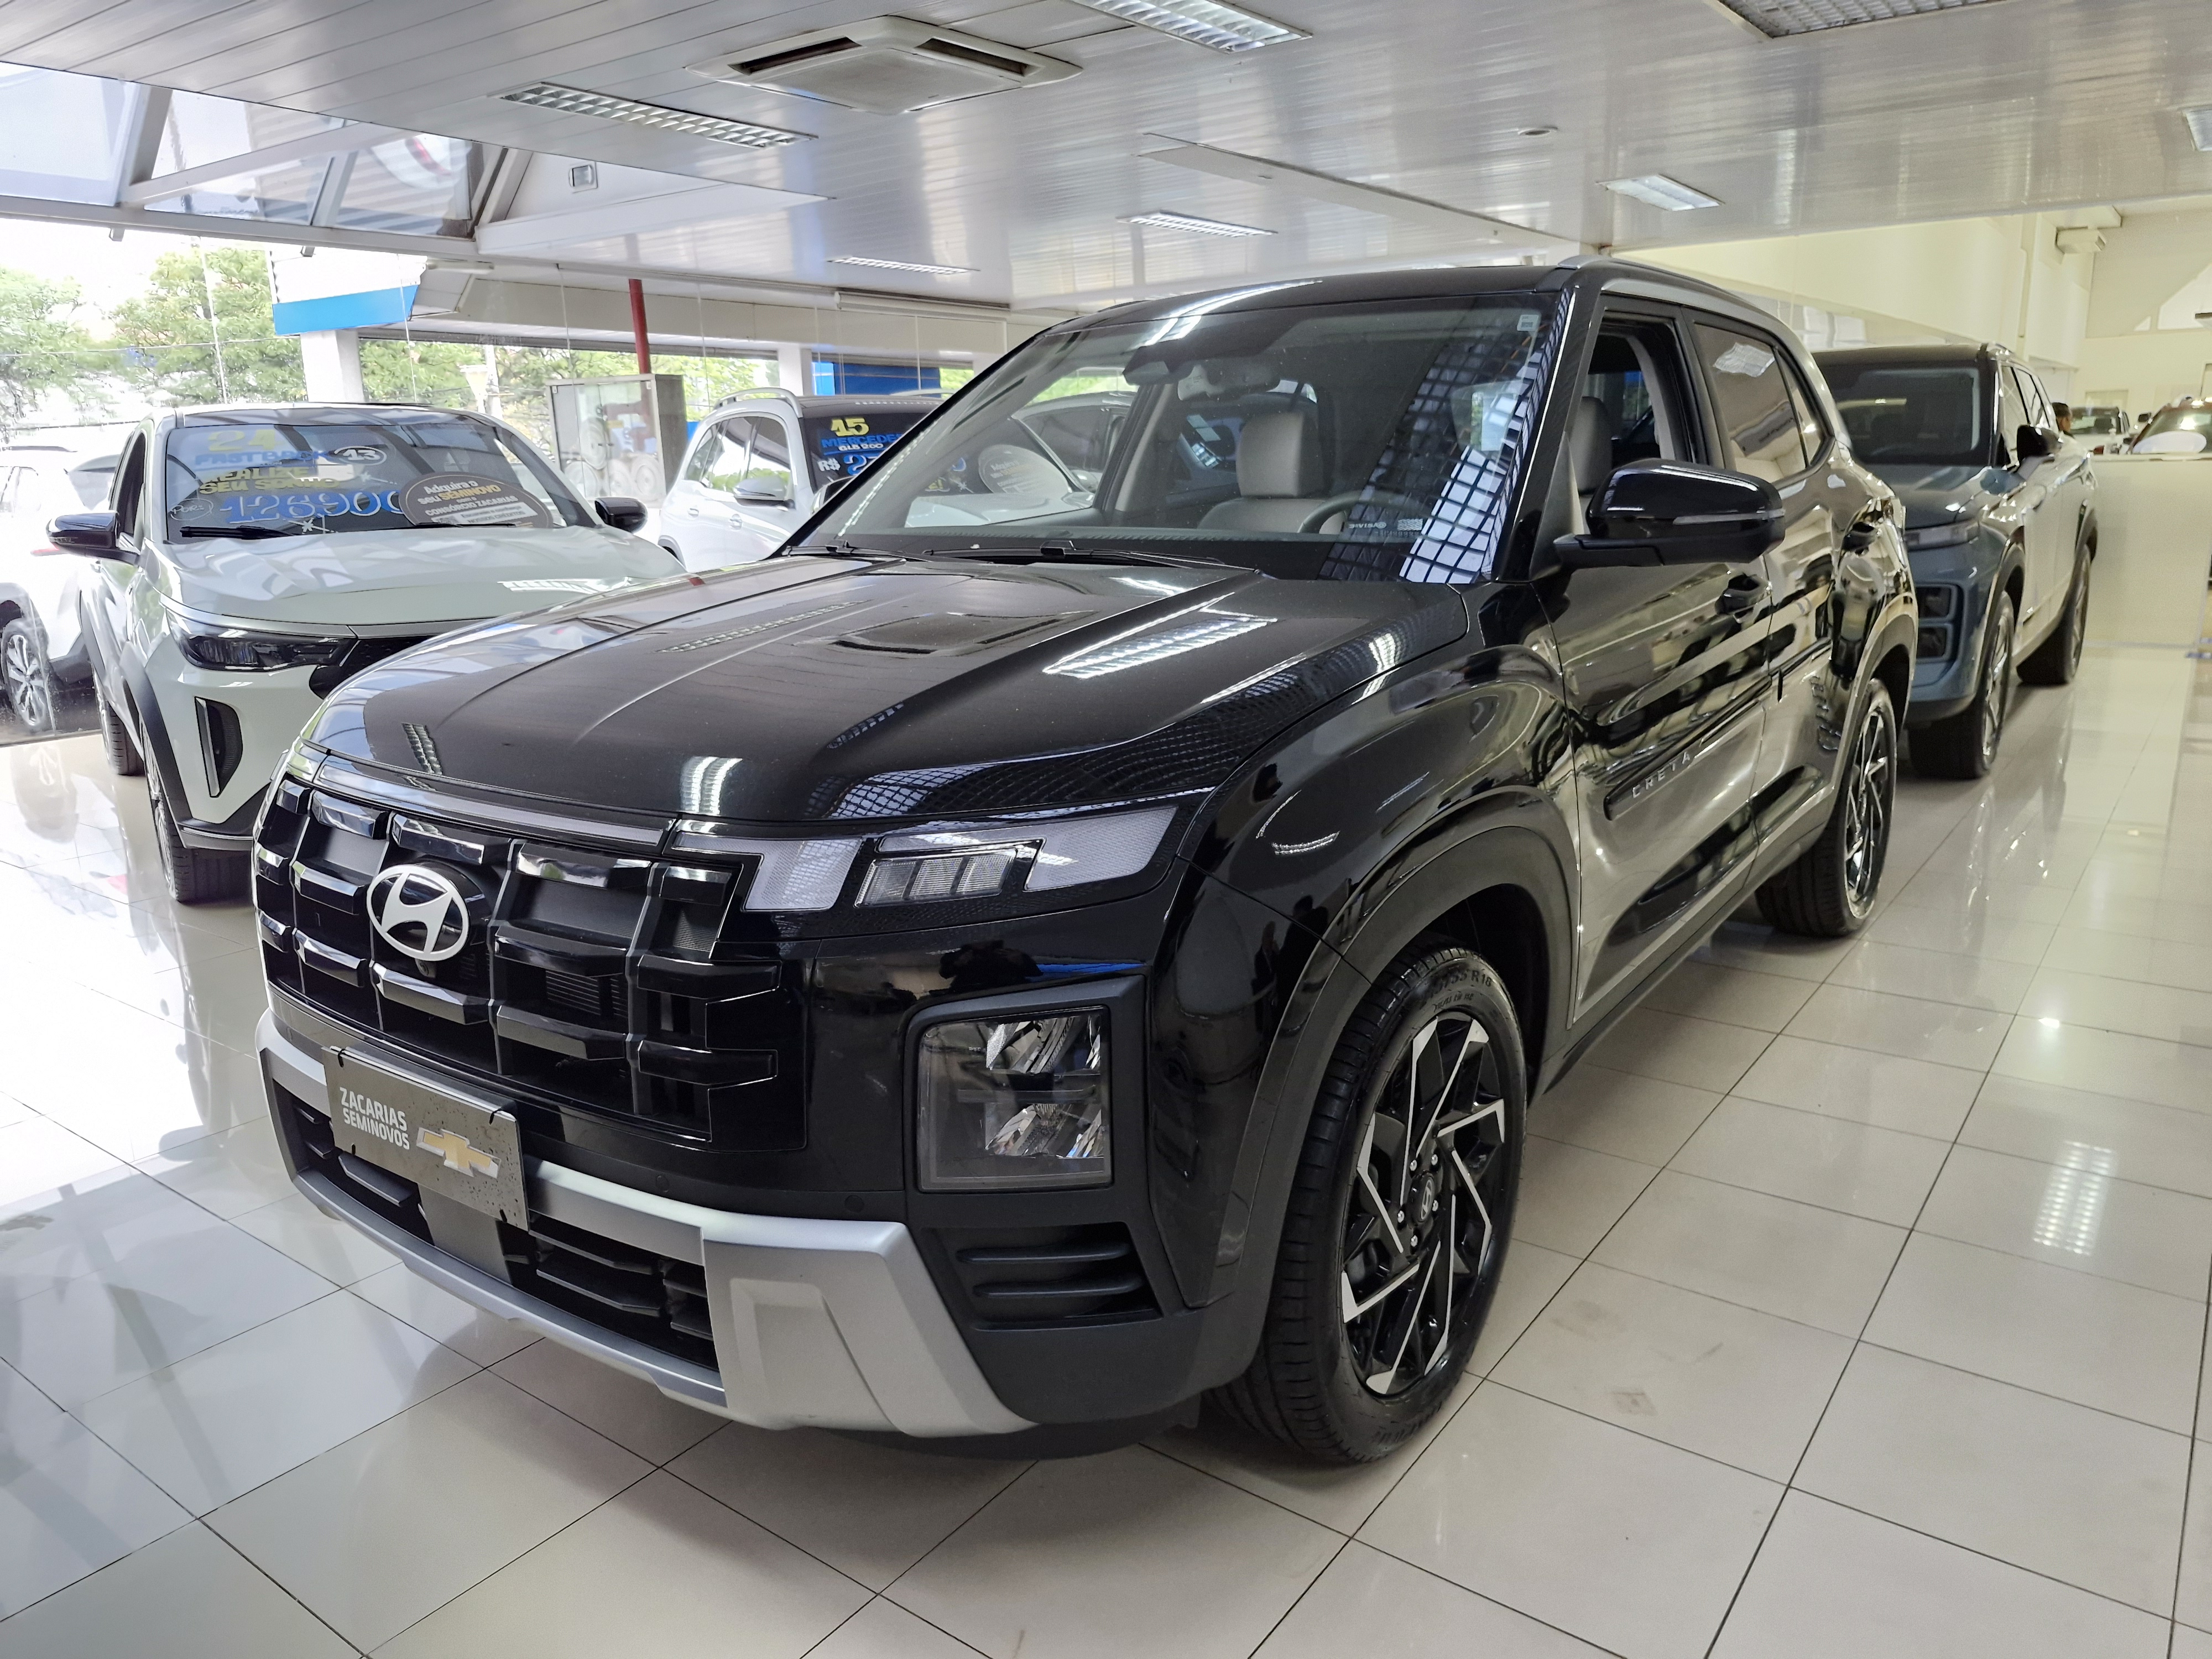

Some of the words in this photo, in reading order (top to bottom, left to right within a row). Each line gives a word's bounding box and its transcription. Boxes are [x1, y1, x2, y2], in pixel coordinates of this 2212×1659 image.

[208, 429, 284, 452] 24
[821, 434, 904, 447] MERCEDE
[818, 457, 841, 472] R$
[418, 495, 442, 505] seu
[439, 484, 502, 500] SEMINOVO
[424, 481, 469, 494] Adquira
[425, 502, 476, 517] CONSÓRCIO
[475, 495, 519, 508] ZACARIAS
[1632, 752, 1690, 799] CRETA
[340, 1087, 407, 1131] ZACARIAS
[343, 1107, 410, 1150] SEMINOVOS
